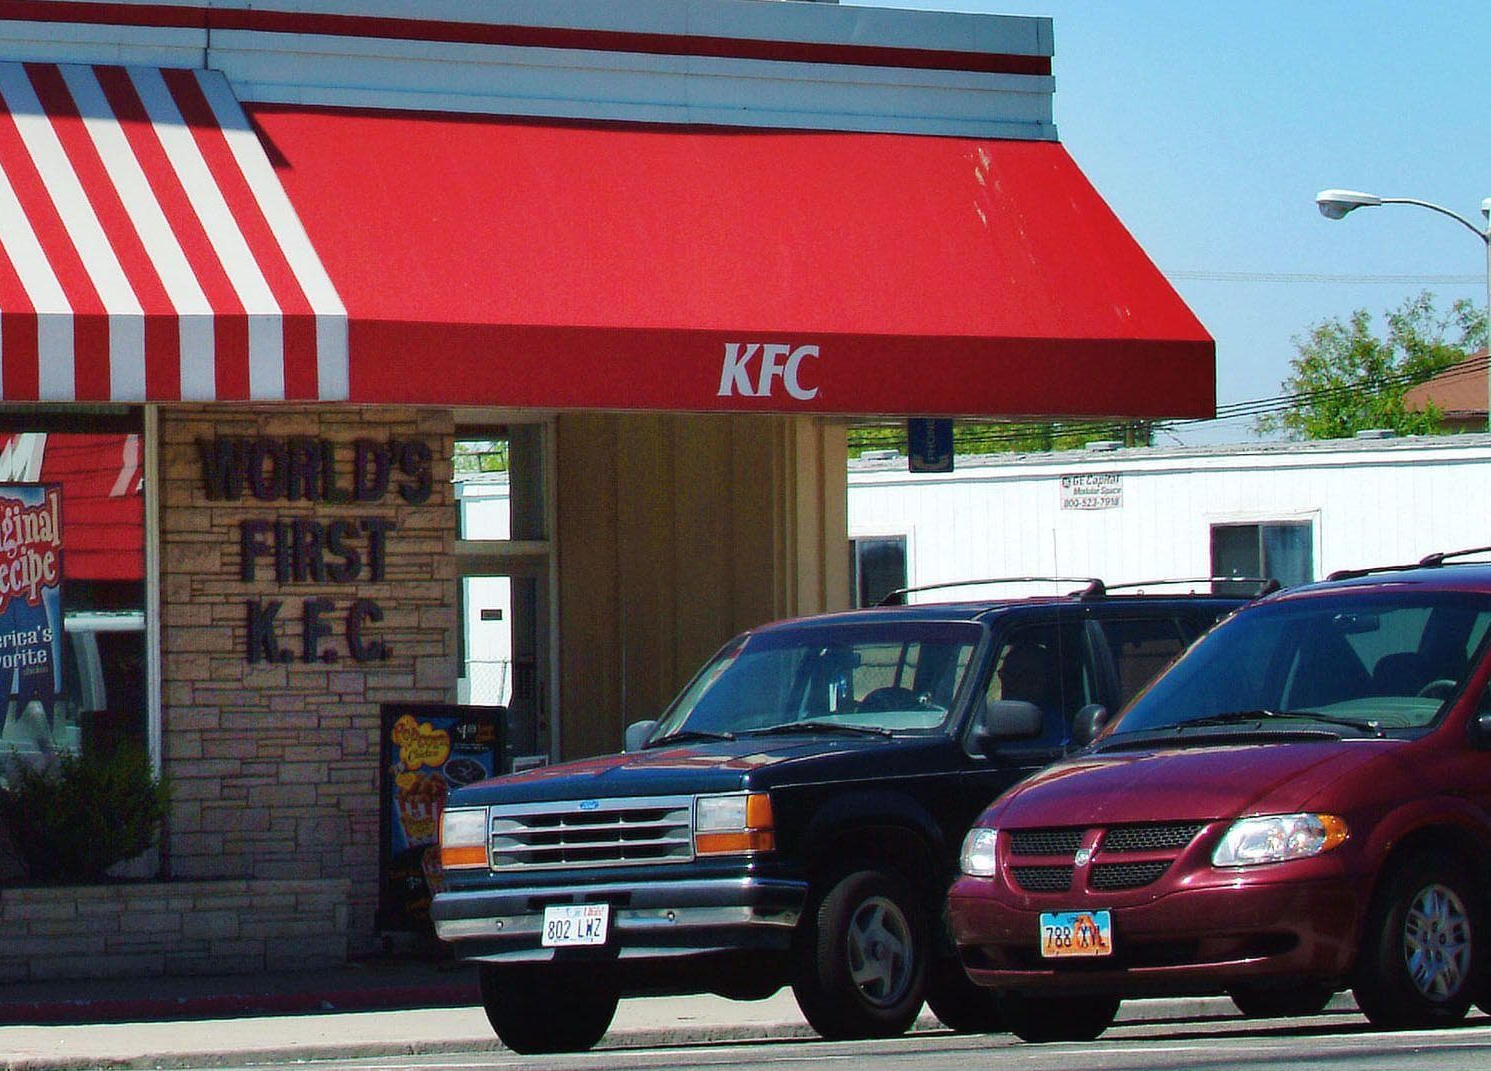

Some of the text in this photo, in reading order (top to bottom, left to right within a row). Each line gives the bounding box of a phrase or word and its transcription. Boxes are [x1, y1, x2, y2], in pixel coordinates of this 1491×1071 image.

[717, 342, 820, 401] KFC
[195, 436, 434, 505] WORLD'S
[240, 516, 398, 583] FIRST
[548, 919, 571, 940] 802
[1045, 926, 1072, 948] 788
